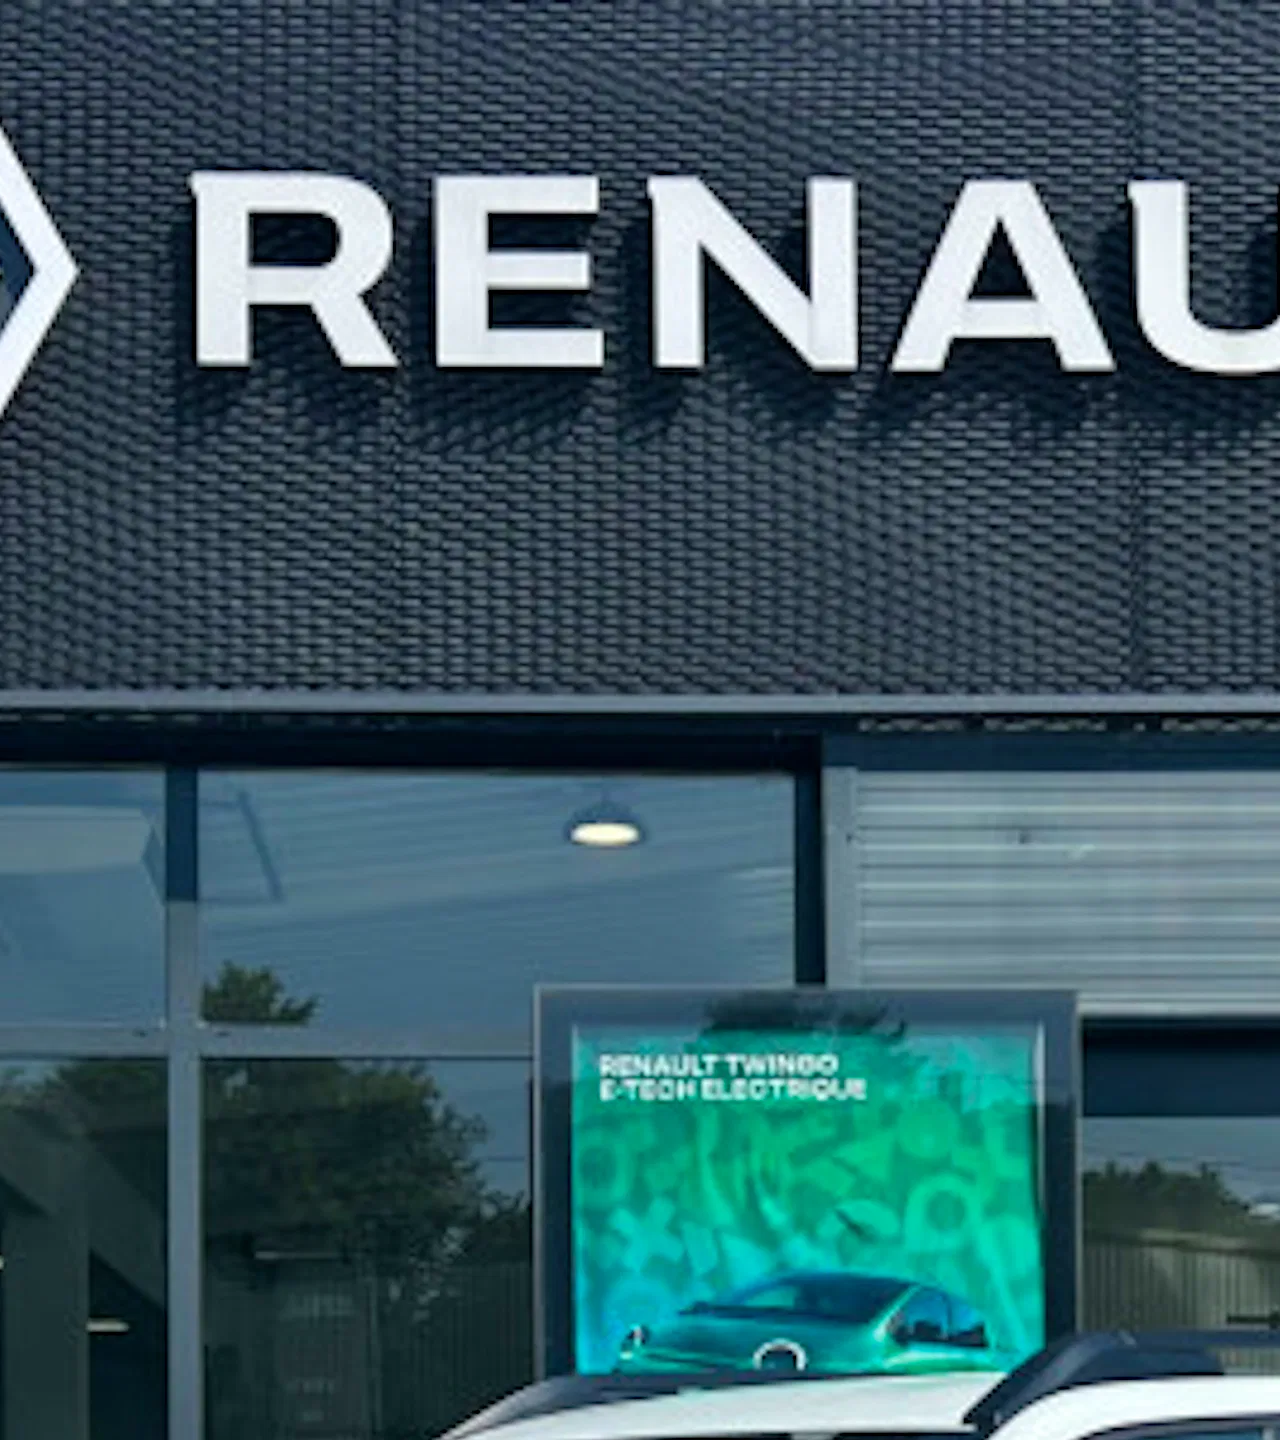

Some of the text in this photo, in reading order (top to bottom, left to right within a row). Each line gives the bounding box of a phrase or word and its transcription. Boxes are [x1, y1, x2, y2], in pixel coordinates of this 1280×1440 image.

[599, 1054, 839, 1077] RENAULT TWINGO
[599, 1078, 868, 1102] E-TECH ELECTRIQUE
